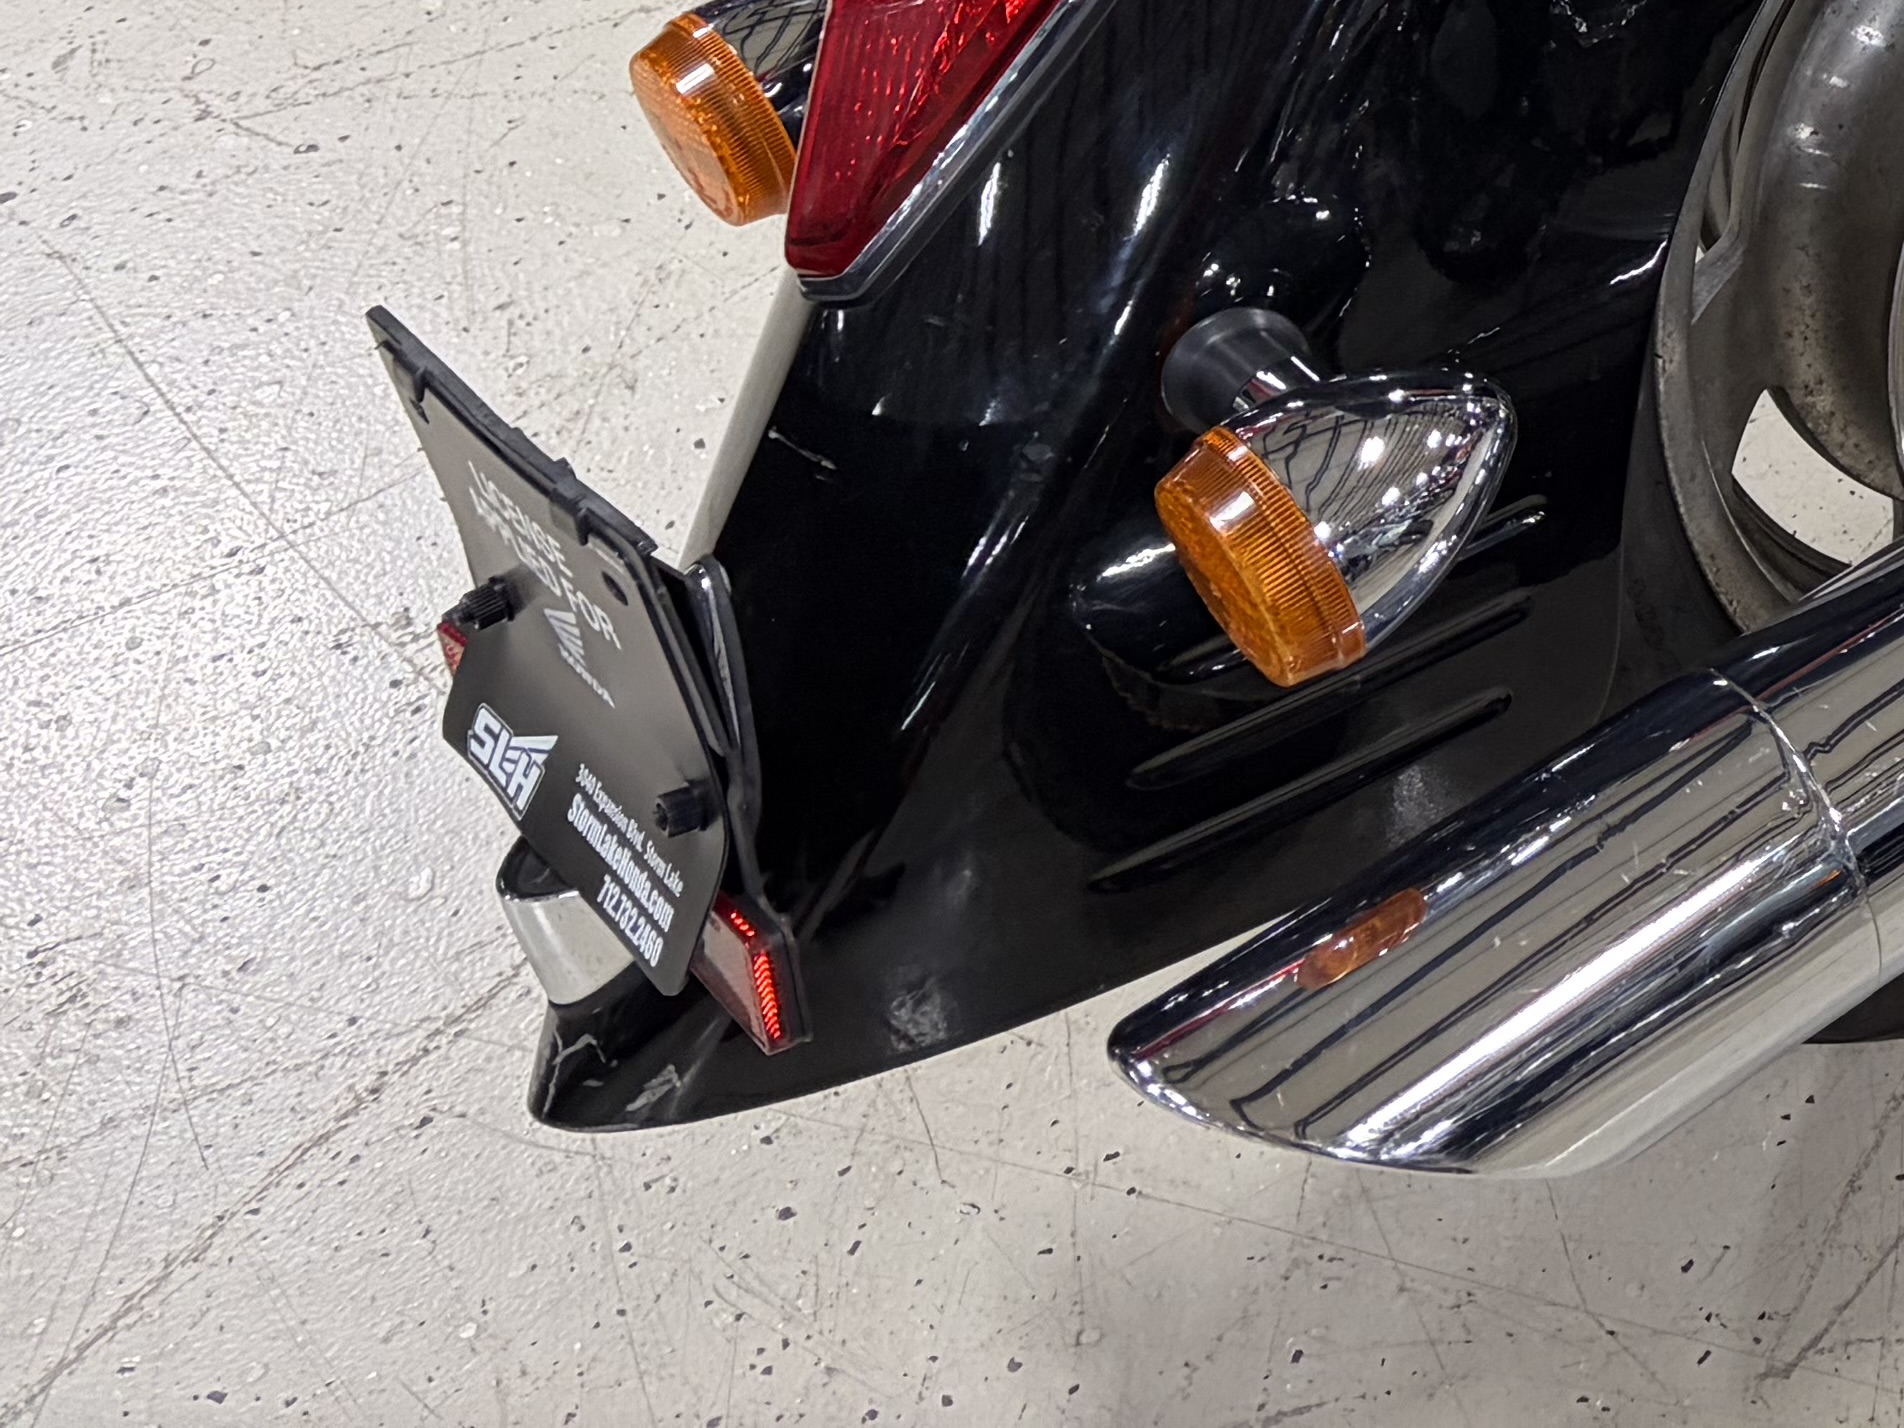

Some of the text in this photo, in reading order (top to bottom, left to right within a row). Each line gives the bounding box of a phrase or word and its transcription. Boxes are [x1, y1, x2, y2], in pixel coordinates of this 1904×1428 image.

[467, 459, 574, 579] LICENSE
[560, 576, 622, 651] FOR
[566, 793, 676, 933] StormLakeHonda.com
[594, 781, 630, 832] Expansion
[643, 839, 667, 877] Storm
[664, 861, 685, 898] Lake
[595, 873, 664, 968] 712.732.2460
